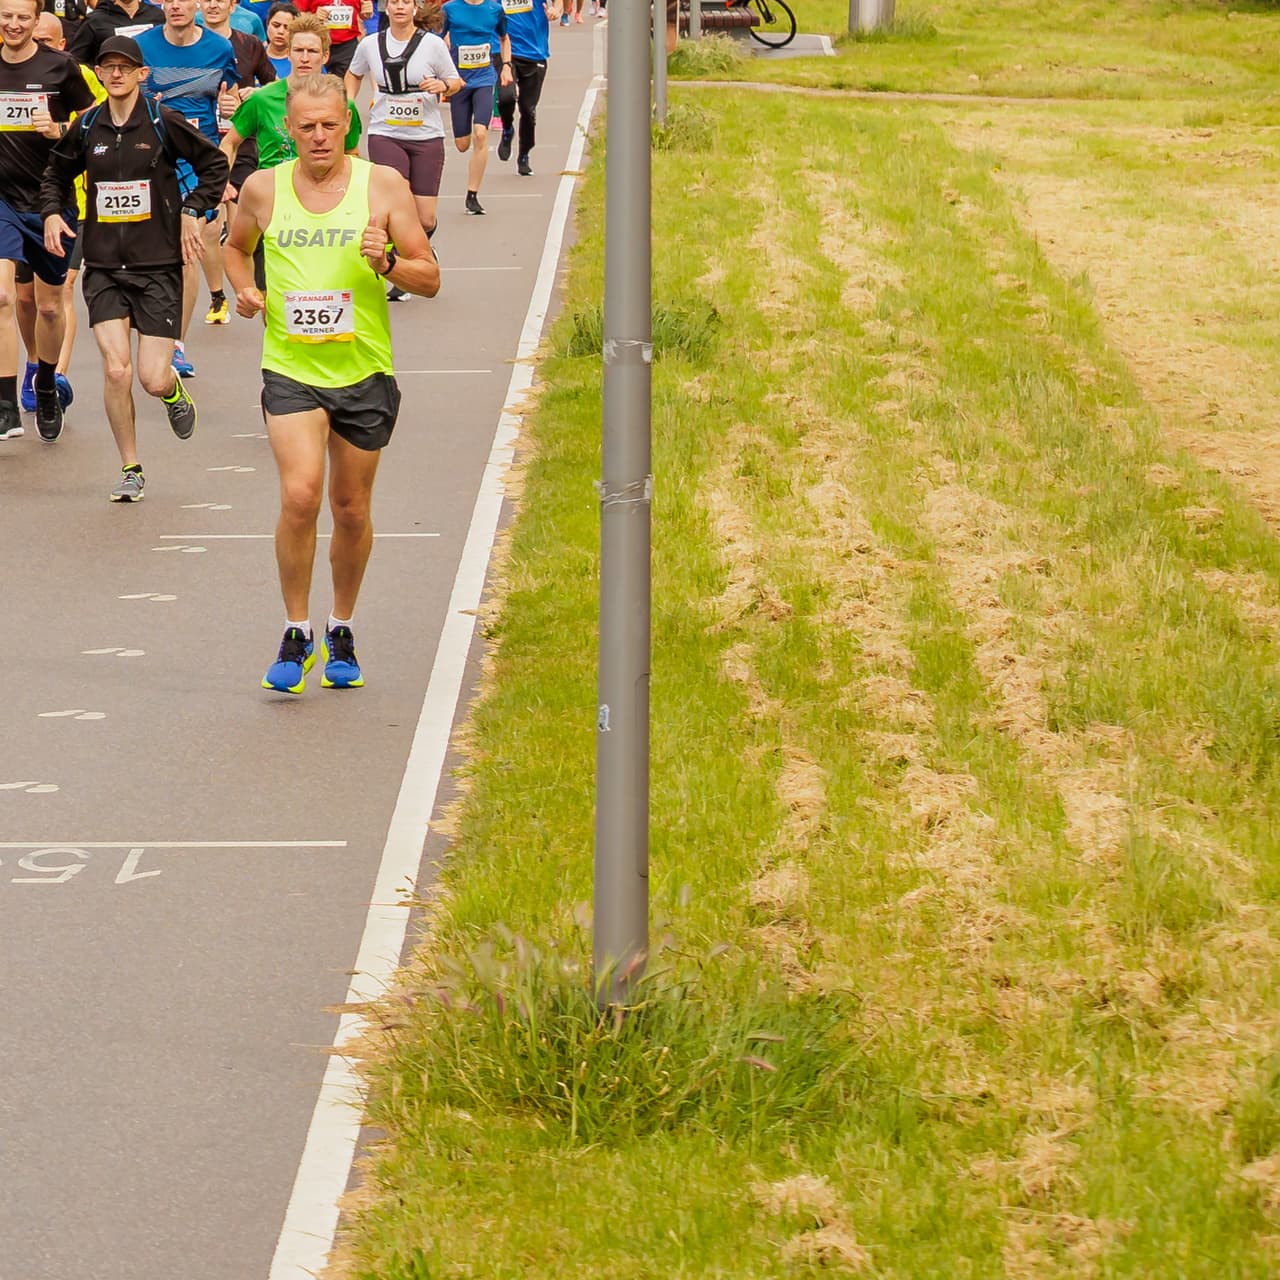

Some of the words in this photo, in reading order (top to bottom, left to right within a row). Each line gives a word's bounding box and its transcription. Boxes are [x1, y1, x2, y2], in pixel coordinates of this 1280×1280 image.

[463, 51, 486, 61] 2399
[389, 106, 419, 115] 2006
[104, 195, 141, 208] 2125
[277, 228, 356, 248] USATF
[293, 308, 344, 325] 2367
